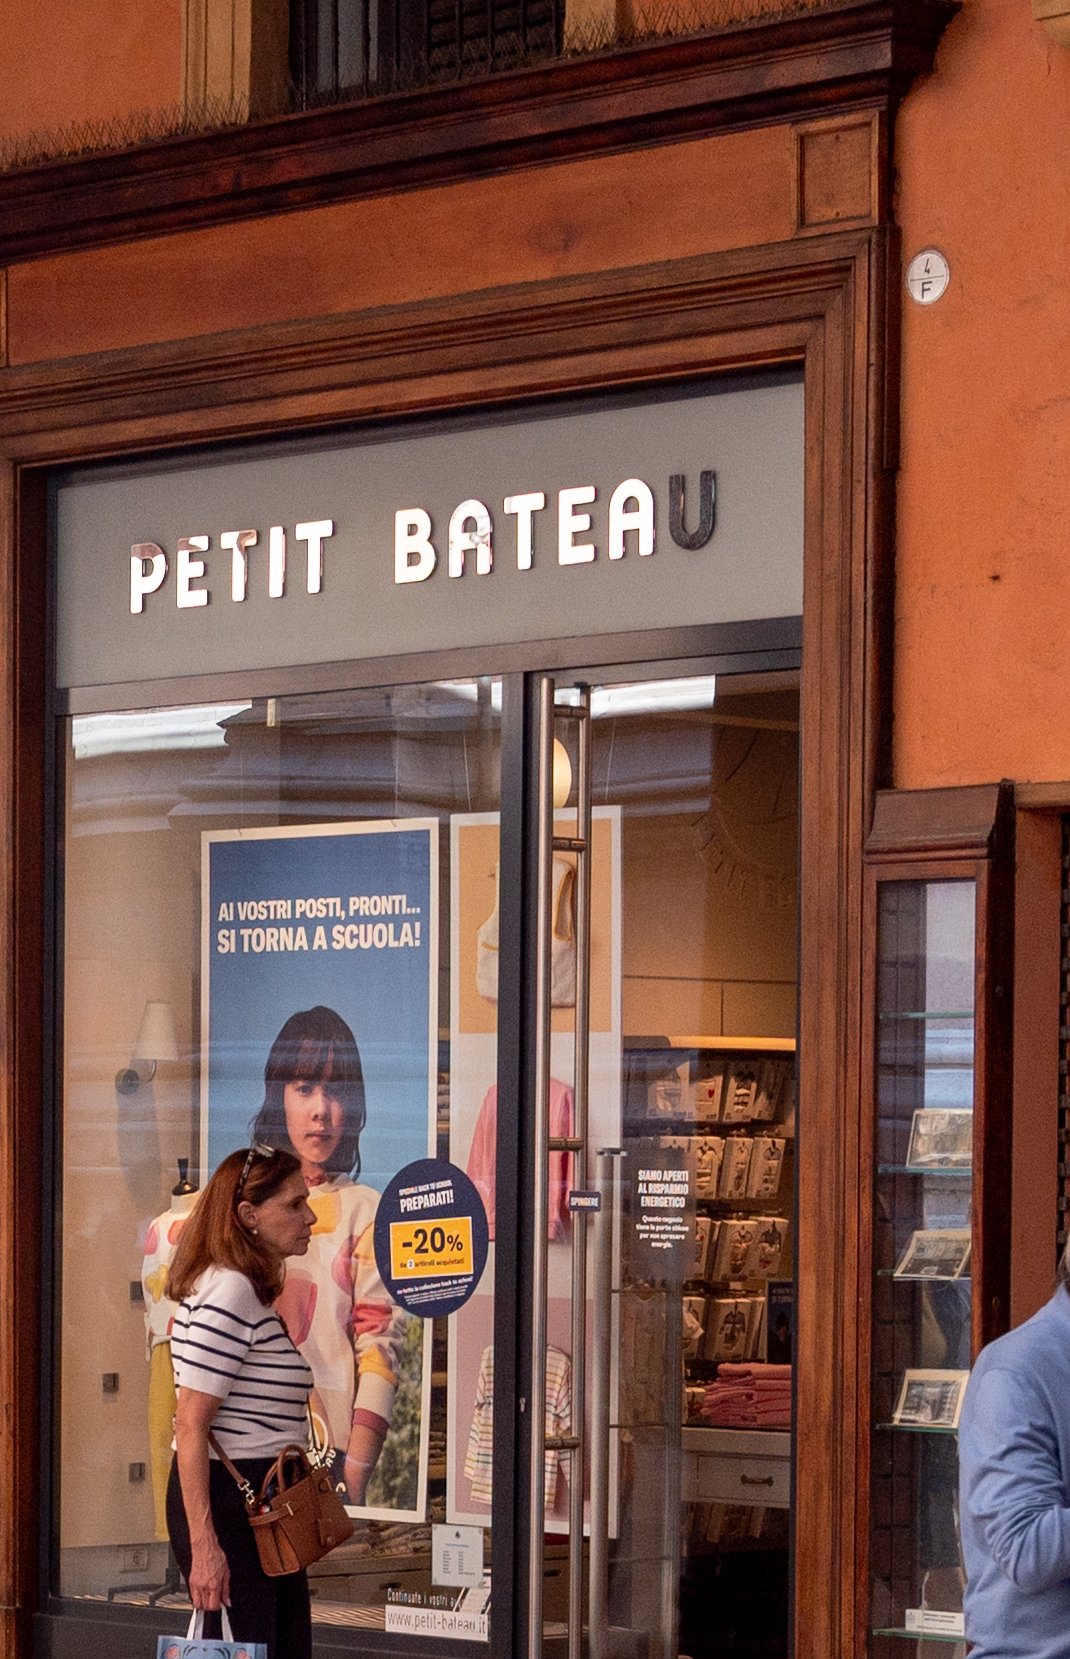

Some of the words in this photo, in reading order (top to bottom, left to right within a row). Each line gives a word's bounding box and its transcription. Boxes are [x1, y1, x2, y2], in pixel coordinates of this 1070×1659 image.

[924, 257, 931, 275] 4
[921, 280, 933, 299] F
[129, 520, 335, 614] PETIT
[394, 469, 718, 585] BATEAU
[218, 902, 234, 921] AI
[237, 900, 292, 921] VOSTRI
[295, 897, 346, 921] POSTI,
[349, 894, 421, 916] PRONTI...
[217, 928, 236, 954] SI
[240, 926, 309, 953] TORNA
[312, 925, 328, 950] A
[331, 921, 421, 950] SCUOLA!
[637, 1169, 662, 1182] SIAMO
[663, 1169, 689, 1182] APERTI
[637, 1182, 648, 1194] AL
[648, 1183, 689, 1195] RISPARMIO
[400, 1188, 454, 1213] PREPARATI!
[570, 1197, 599, 1207] SPINGERE
[640, 1196, 686, 1208] ENERGETICO
[402, 1227, 464, 1254] -20%
[387, 1587, 421, 1604] Continuate
[387, 1611, 486, 1634] www.petit-bateau.it
